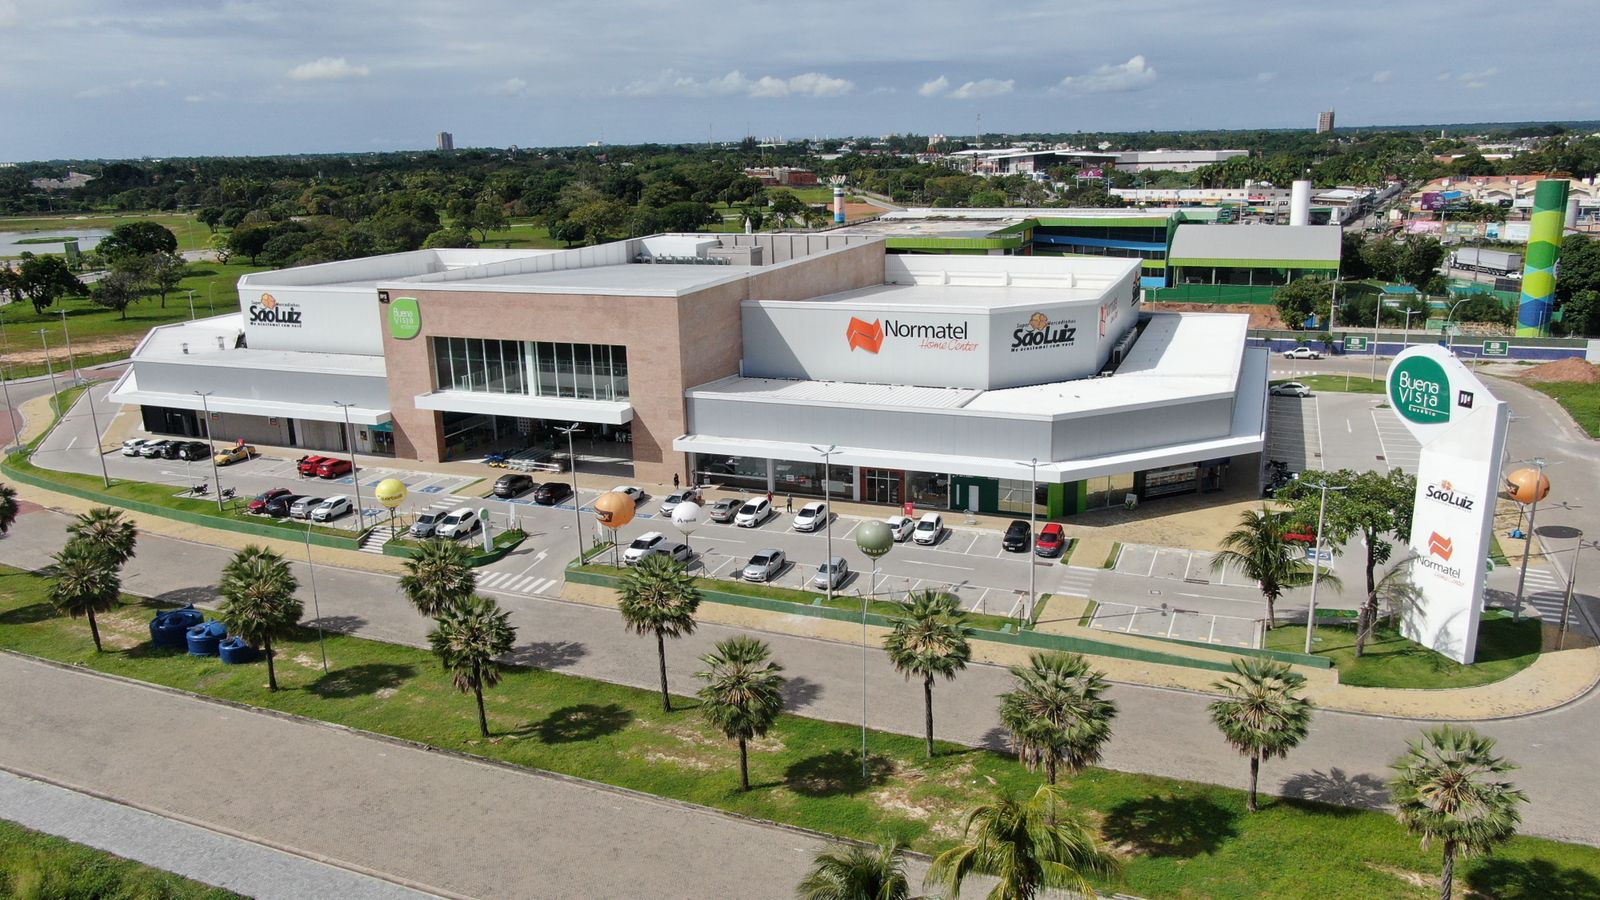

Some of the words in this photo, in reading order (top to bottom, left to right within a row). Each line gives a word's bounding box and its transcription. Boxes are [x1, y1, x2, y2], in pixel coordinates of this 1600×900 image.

[885, 319, 968, 340] Normatel
[918, 336, 947, 350] Home
[948, 338, 980, 352] Center
[1399, 370, 1440, 395] Buena
[1398, 386, 1438, 408] Vista
[1416, 554, 1461, 580] Normatel
